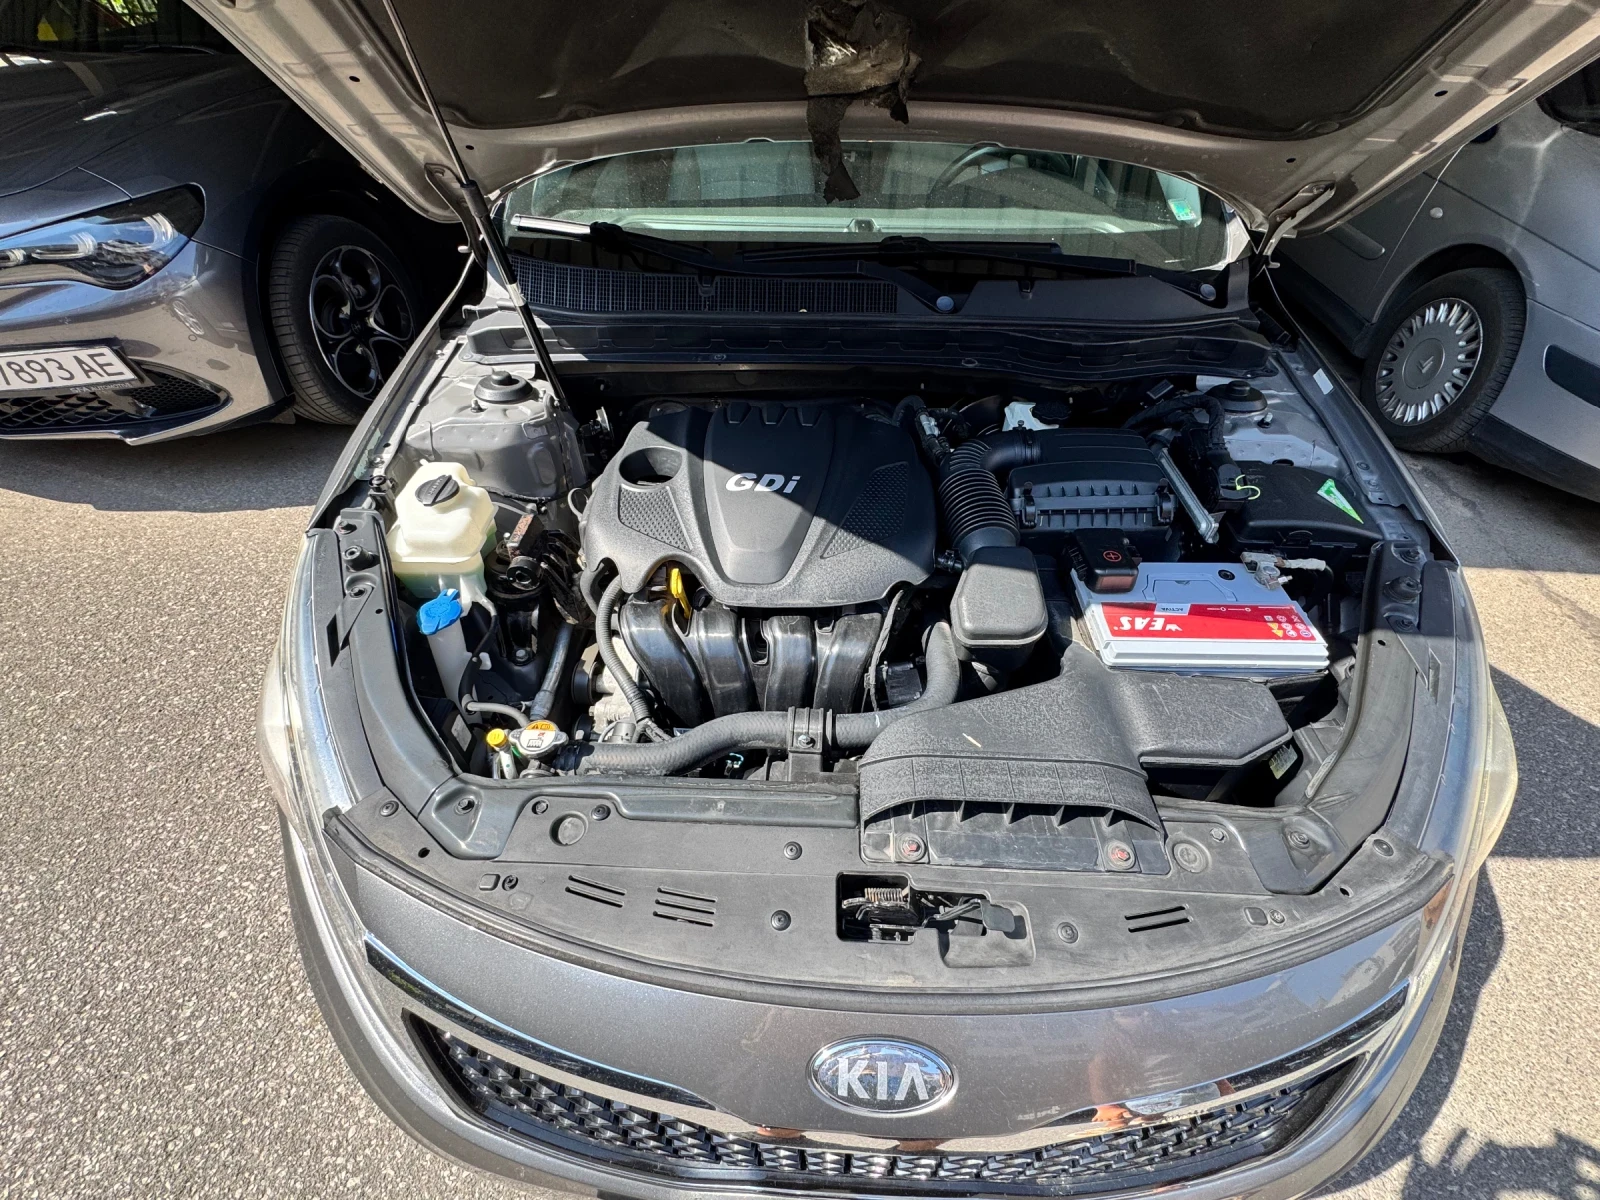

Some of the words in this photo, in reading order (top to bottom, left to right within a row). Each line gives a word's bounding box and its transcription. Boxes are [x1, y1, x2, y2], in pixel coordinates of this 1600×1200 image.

[73, 353, 125, 379] AE
[725, 472, 801, 494] GDi
[836, 1057, 930, 1101] KIA
